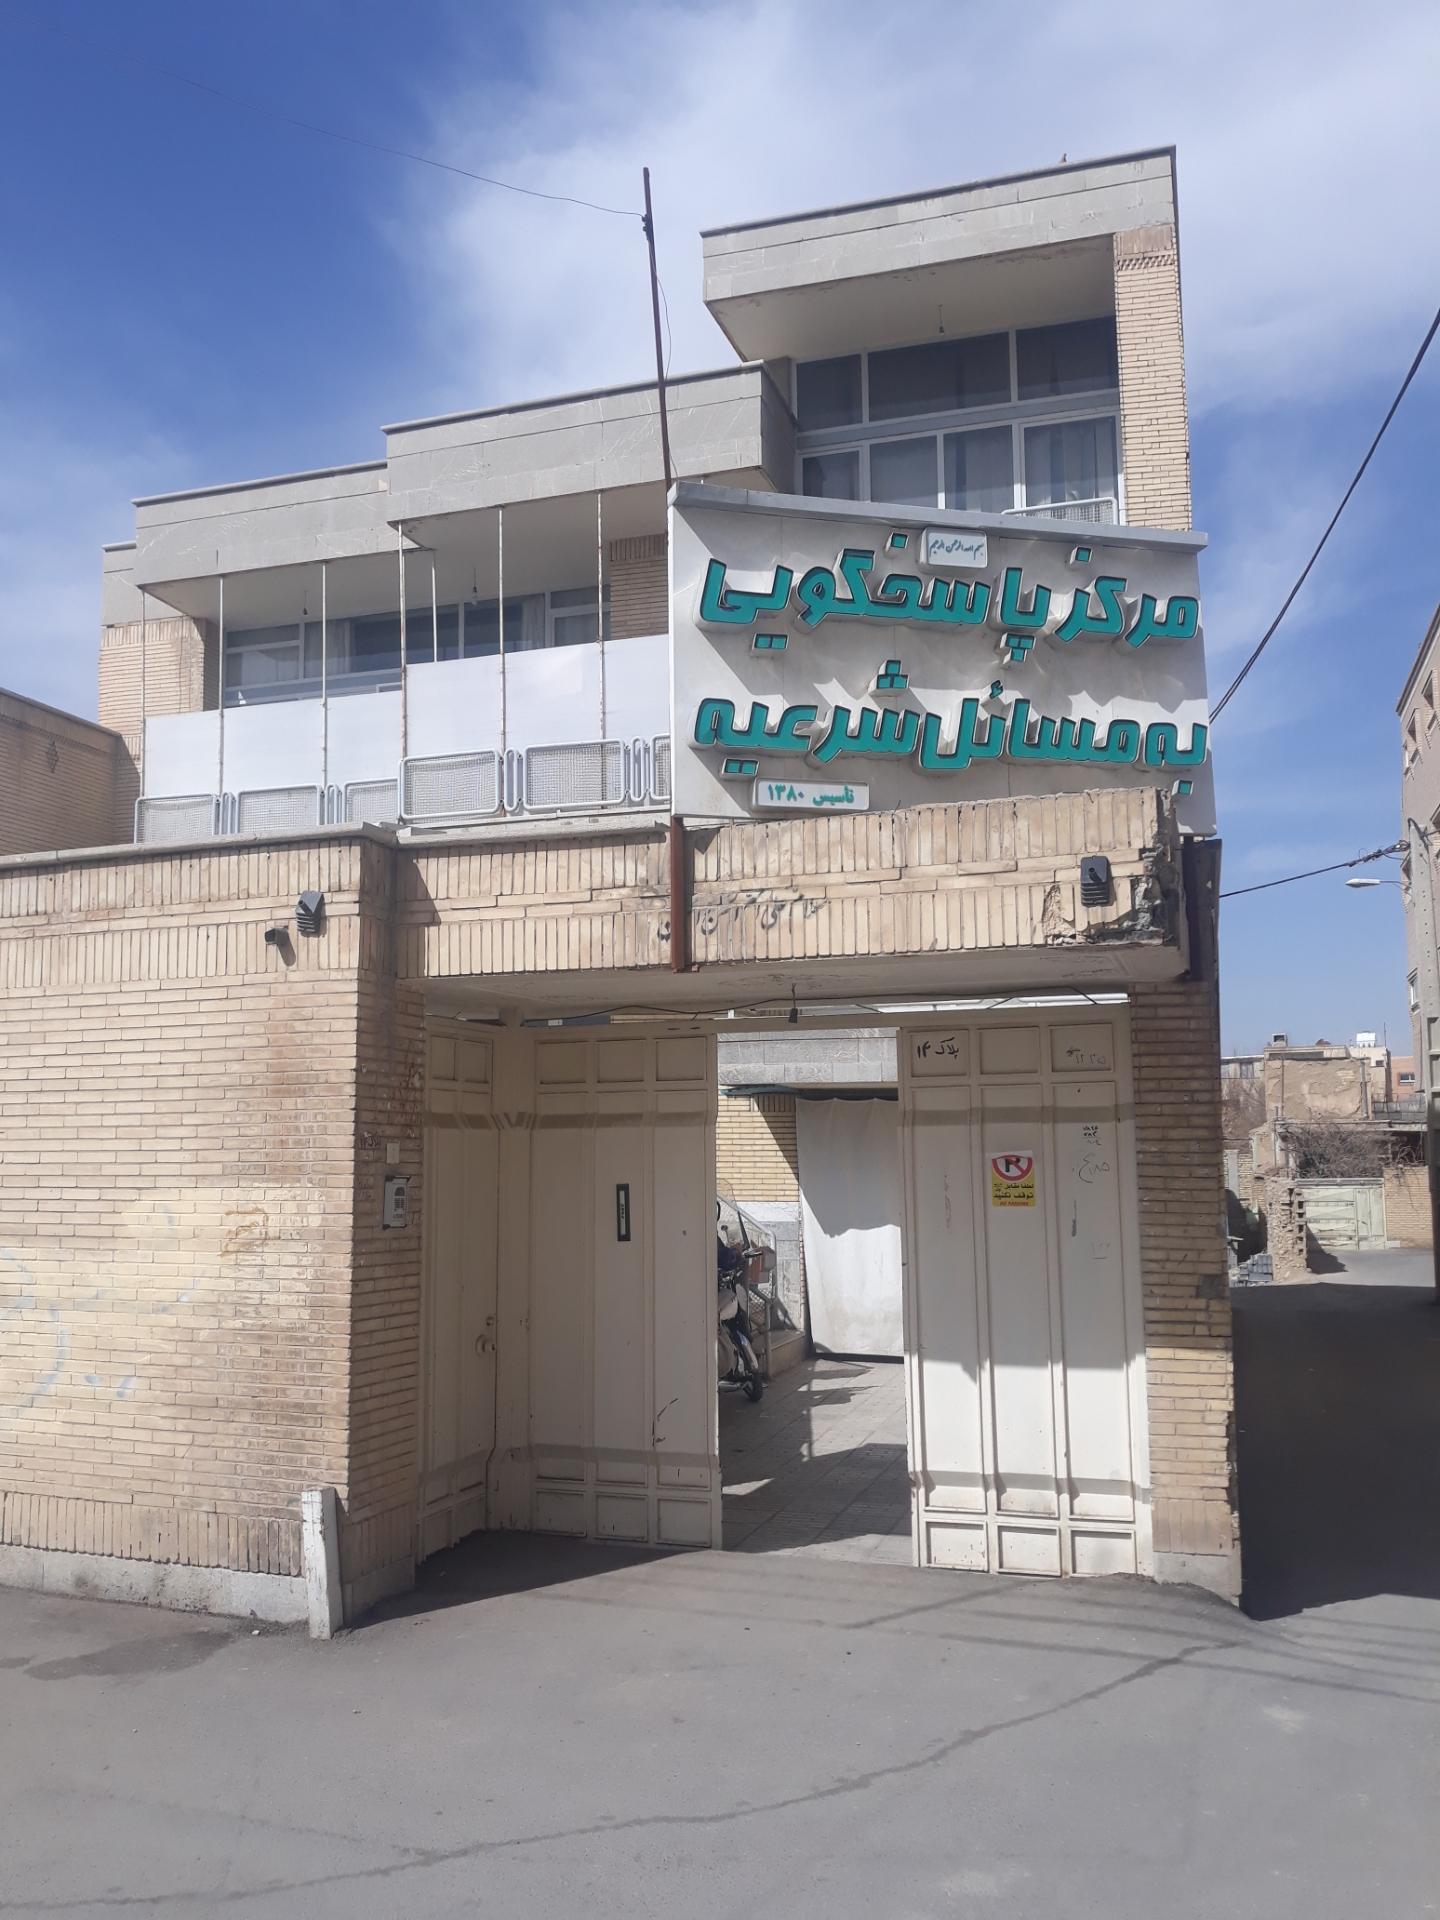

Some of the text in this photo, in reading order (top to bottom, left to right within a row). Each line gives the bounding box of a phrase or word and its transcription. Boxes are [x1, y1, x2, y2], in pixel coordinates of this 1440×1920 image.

[698, 532, 1200, 662] مرکز پاسخگویی
[694, 659, 1208, 796] به مسائل شرعیه
[767, 783, 805, 802] ۱۳۸۰
[916, 1036, 960, 1060] پلاک ۱۴
